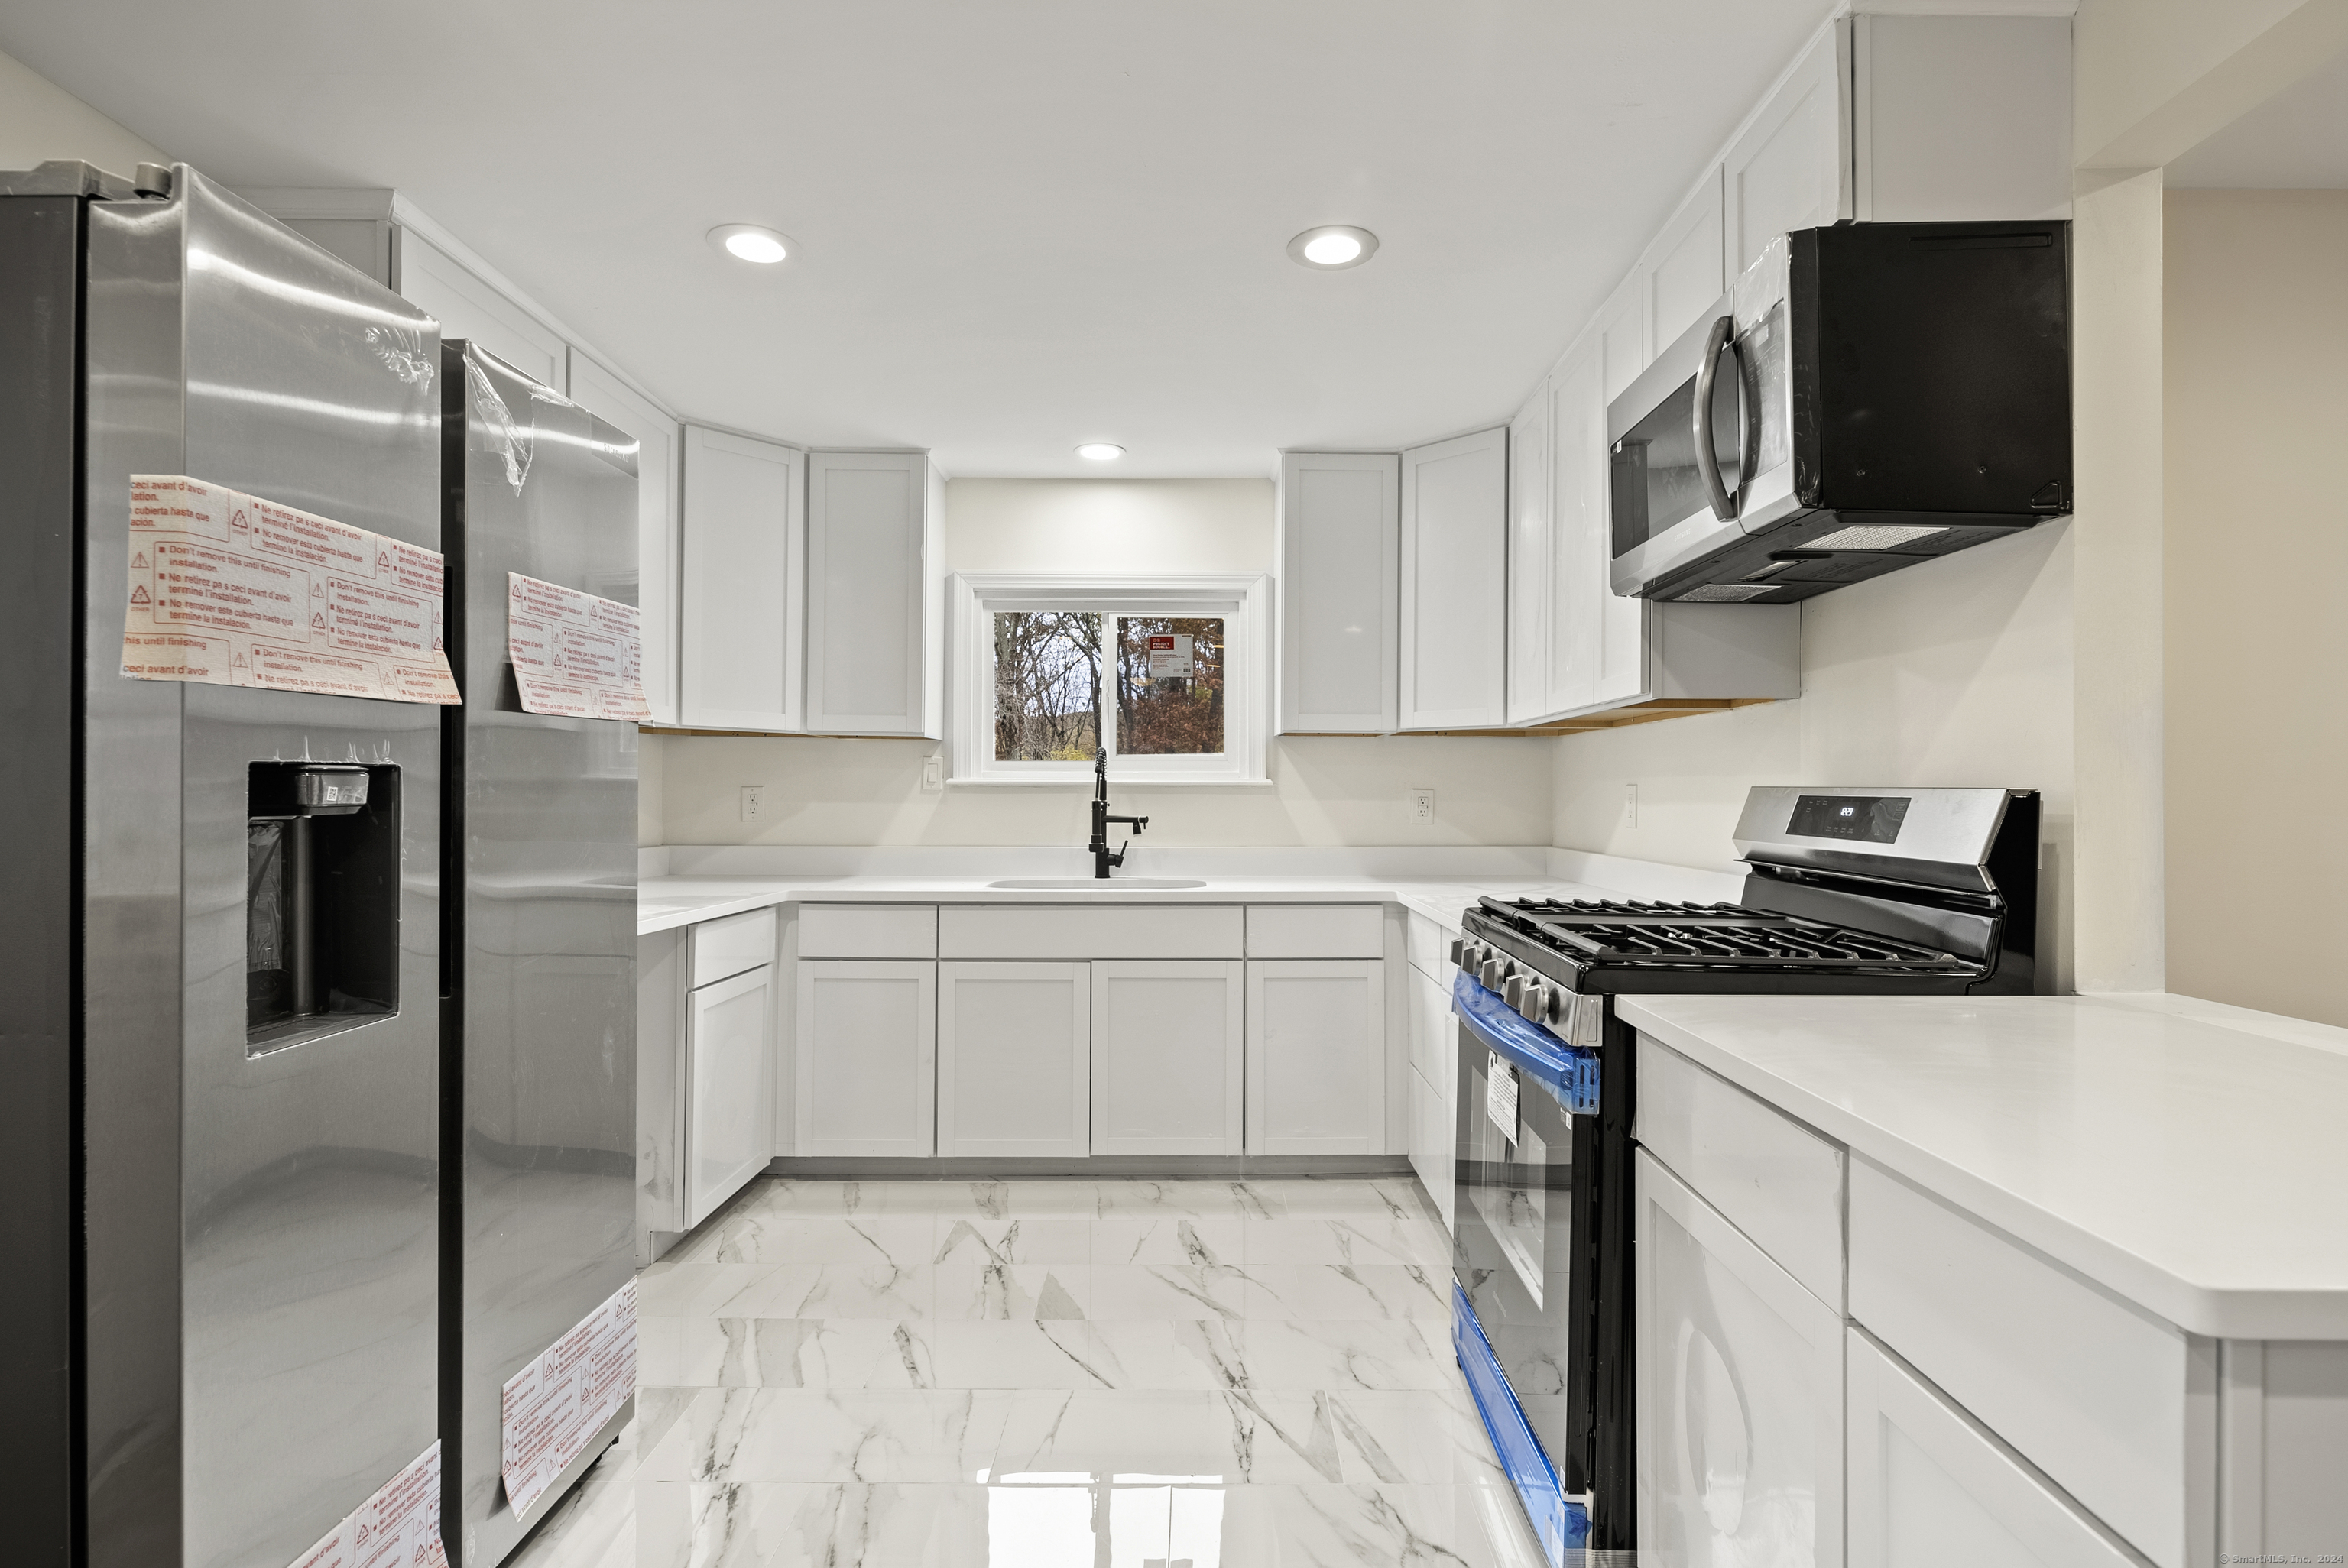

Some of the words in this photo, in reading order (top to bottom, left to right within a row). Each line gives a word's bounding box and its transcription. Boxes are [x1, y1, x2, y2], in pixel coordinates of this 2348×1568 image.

[151, 481, 177, 490] avant
[178, 481, 208, 496] d'avoir
[135, 506, 168, 516] cubierta
[170, 507, 194, 518] hasta
[196, 512, 210, 522] que
[261, 504, 271, 514] Ne
[274, 509, 294, 521] retirez
[296, 517, 304, 525] pa
[311, 521, 324, 530] ceci
[325, 526, 341, 535] avant
[343, 529, 362, 541] d'avoir
[263, 529, 271, 538] No
[274, 532, 298, 546] remover
[300, 539, 312, 549] esta
[314, 542, 336, 556] cubierta
[338, 549, 352, 559] hasta
[353, 554, 363, 563] que
[263, 540, 287, 552] termine
[288, 546, 294, 554] la
[170, 545, 195, 556] Don't
[197, 550, 226, 562] remove
[228, 556, 242, 567] this
[244, 560, 260, 570] until
[261, 563, 291, 579] finishing
[170, 558, 219, 573] installation.
[169, 572, 181, 582] Ne
[184, 575, 210, 587] retirez
[212, 581, 222, 590] pa
[231, 584, 246, 594] ceci
[248, 588, 268, 598] avant
[269, 591, 292, 603] d'avoir
[205, 588, 254, 606] l'installation.
[336, 582, 352, 591] Don't
[354, 587, 374, 597] remove
[375, 591, 384, 600] this
[398, 596, 420, 608] finishing
[337, 592, 369, 606] installation.
[170, 598, 182, 607] No
[185, 601, 216, 613] remover
[218, 606, 232, 616] esta
[235, 609, 261, 620] cubierta
[263, 613, 281, 624] hasta
[282, 617, 294, 626] que
[170, 611, 202, 622] termine
[204, 614, 210, 623] la
[336, 604, 345, 614] Ne
[346, 607, 363, 618] retirez
[377, 614, 388, 623] ceci
[389, 617, 403, 626] avant
[404, 620, 420, 629] d'avoir
[144, 637, 165, 646] until
[168, 637, 206, 650] finishing
[263, 648, 282, 659] Don't
[284, 653, 308, 663] remove
[310, 656, 322, 664] this
[323, 658, 336, 666] until
[337, 659, 363, 671] finishing
[264, 660, 303, 672] installation.
[123, 664, 144, 673] ceci
[147, 665, 175, 674] avant
[178, 665, 209, 676] d'avoir
[319, 1536, 340, 1558] d'avoir
[378, 1534, 400, 1558] finishing
